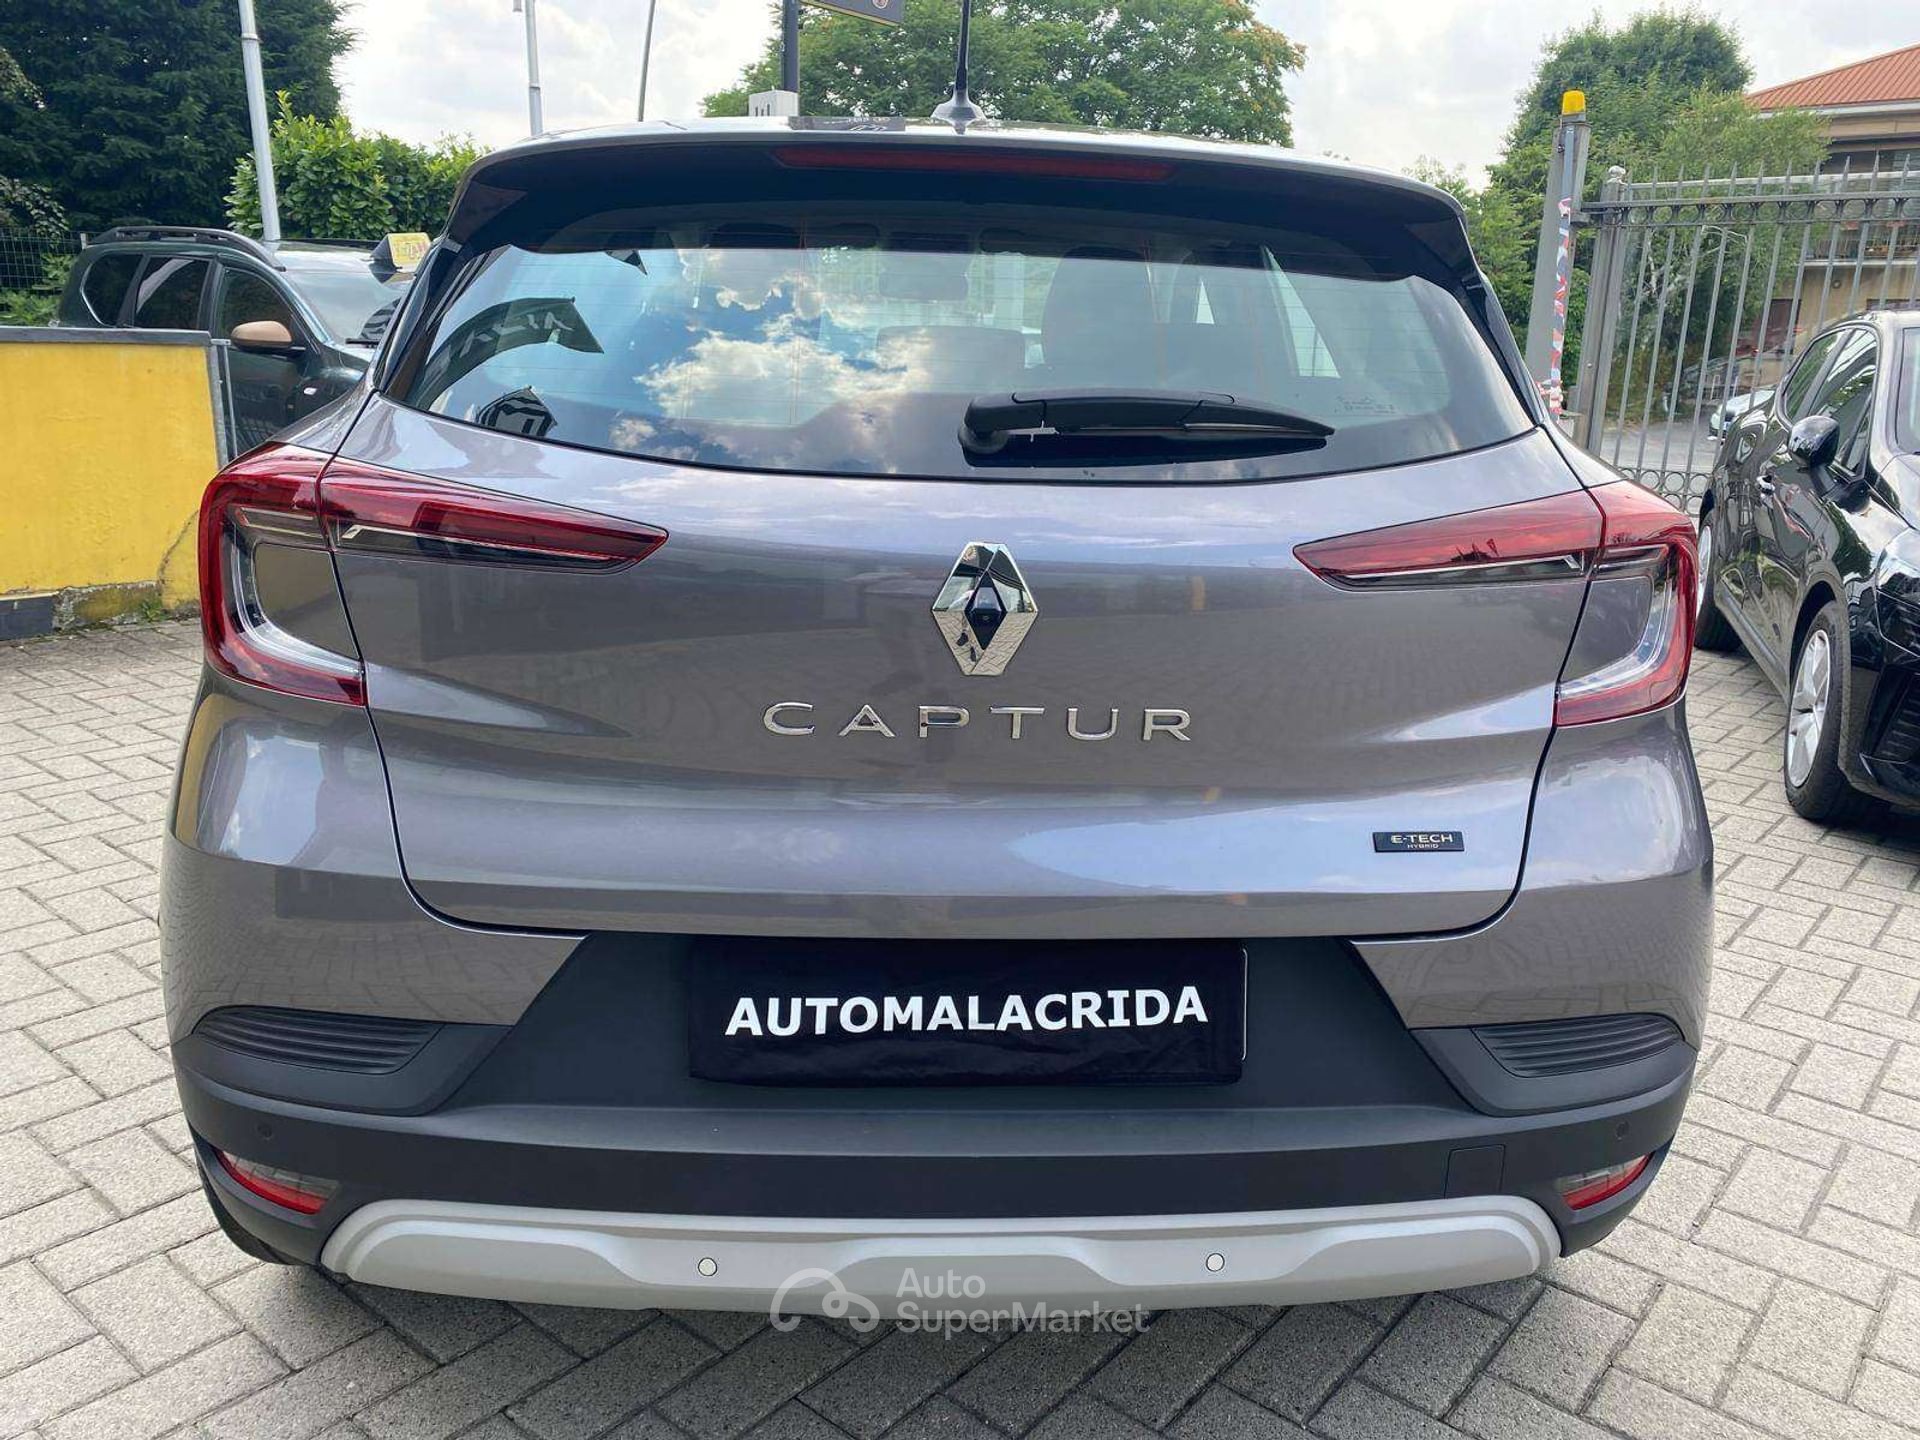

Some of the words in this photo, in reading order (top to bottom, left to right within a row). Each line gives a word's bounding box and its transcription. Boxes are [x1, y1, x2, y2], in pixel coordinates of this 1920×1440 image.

[763, 702, 1191, 742] CAPTUR
[1390, 834, 1454, 844] E-TECH
[724, 985, 1208, 1036] AUTOMALACRIDA
